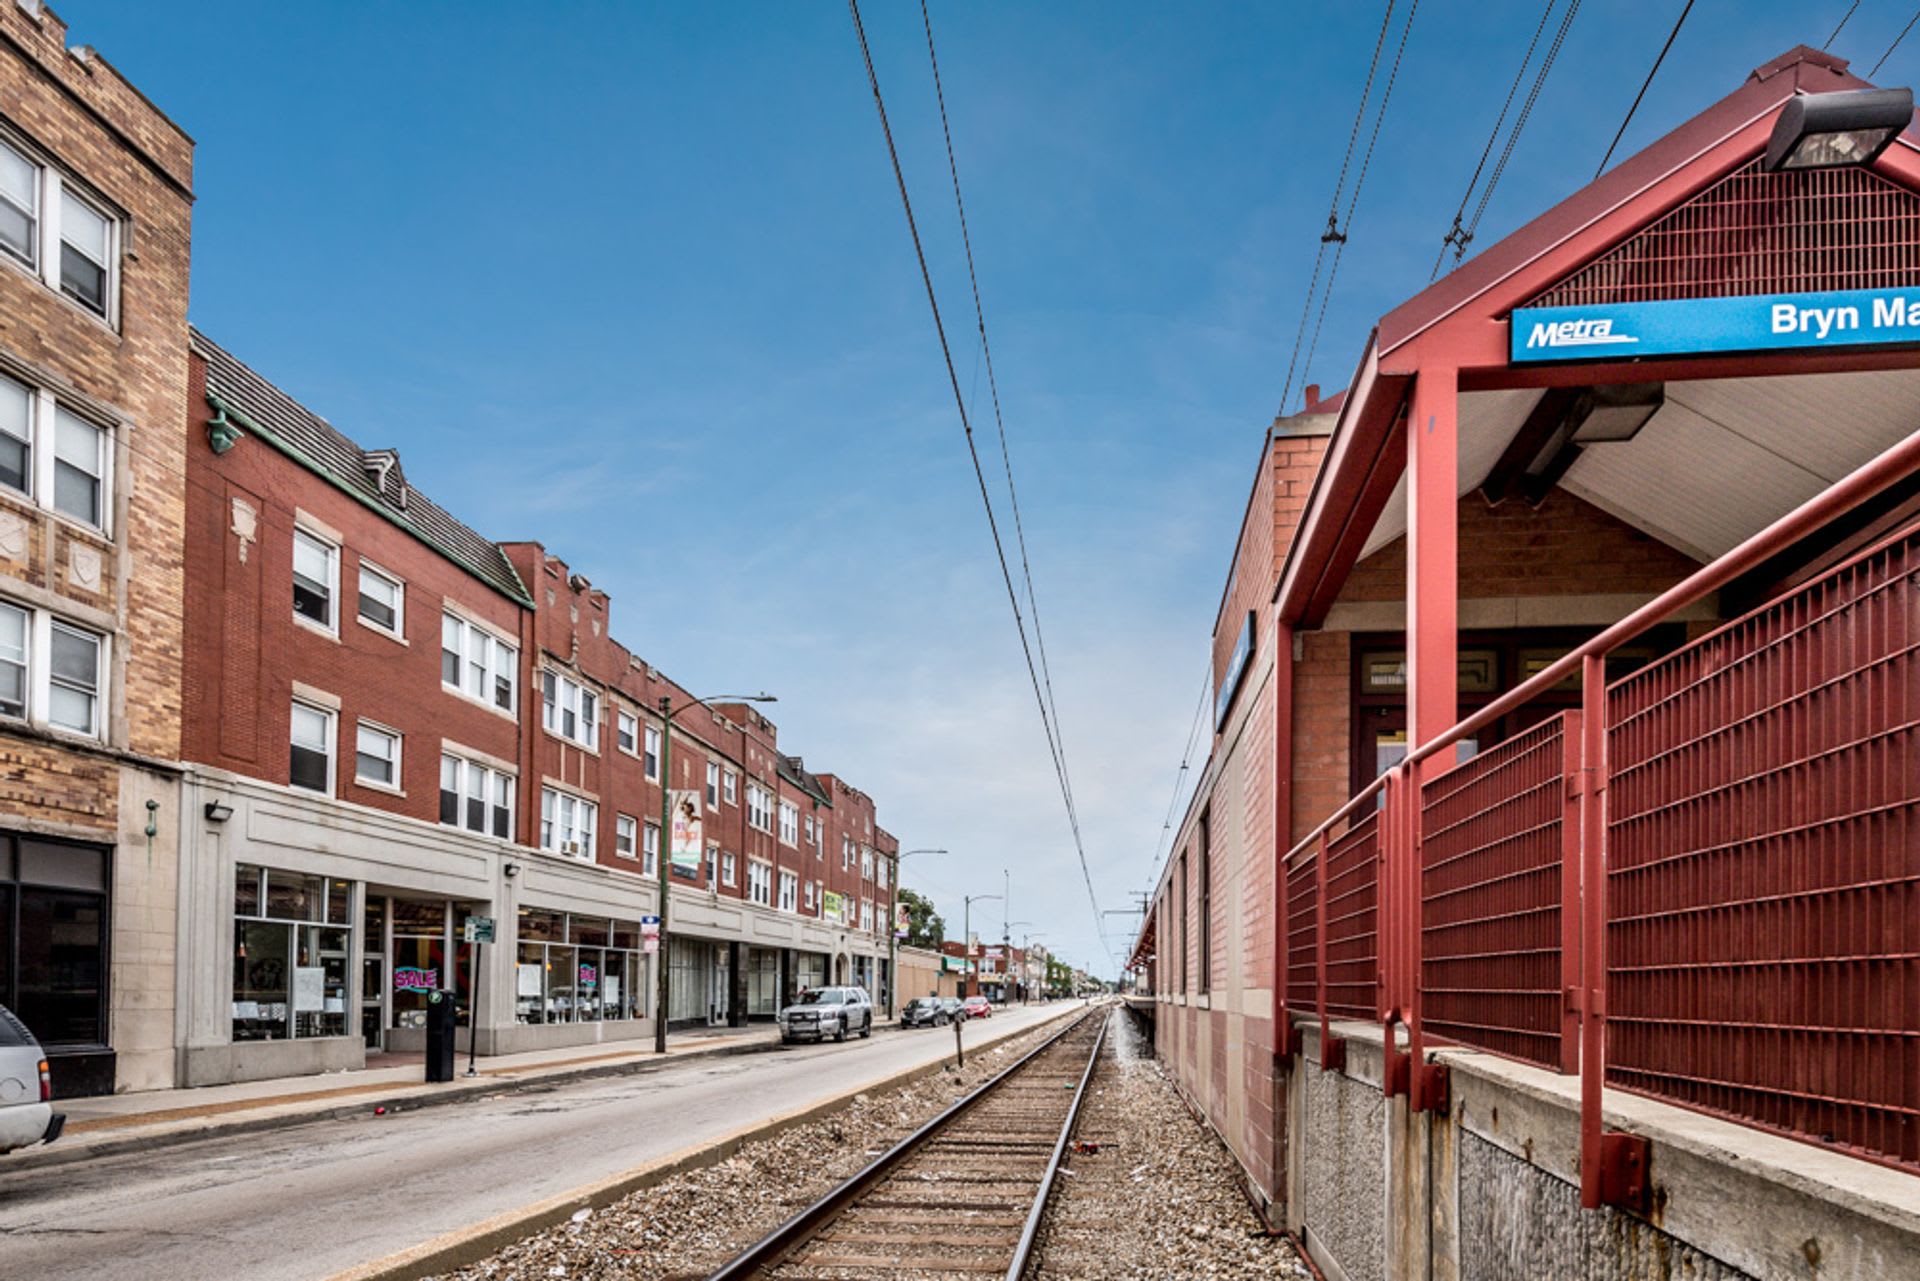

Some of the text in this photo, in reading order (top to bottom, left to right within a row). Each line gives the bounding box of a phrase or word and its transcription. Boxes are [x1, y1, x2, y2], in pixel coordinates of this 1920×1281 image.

[1526, 318, 1616, 348] Metra
[1771, 303, 1859, 339] Bryn
[394, 970, 437, 987] SALE
